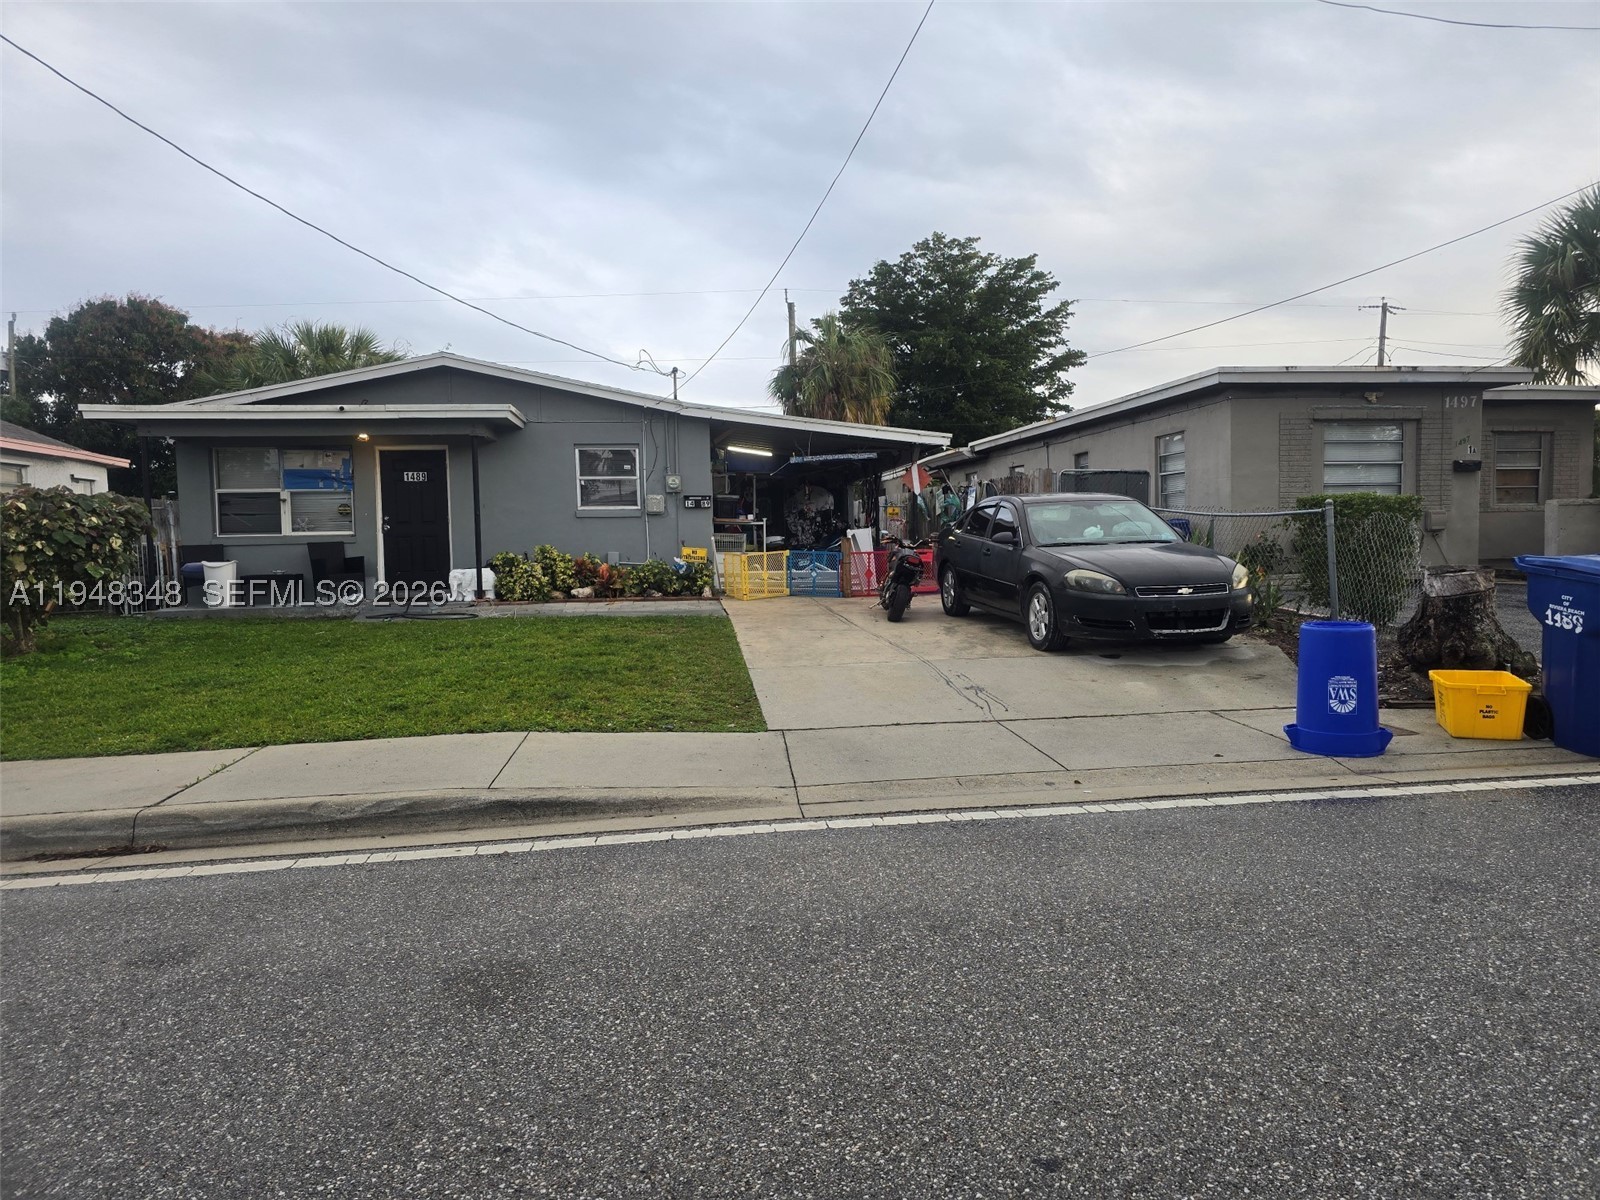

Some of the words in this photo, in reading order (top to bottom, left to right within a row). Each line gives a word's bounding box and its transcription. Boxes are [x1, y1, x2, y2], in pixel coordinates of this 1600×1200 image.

[1445, 395, 1477, 408] 1497
[404, 472, 427, 481] 1489
[1329, 687, 1357, 701] SWA
